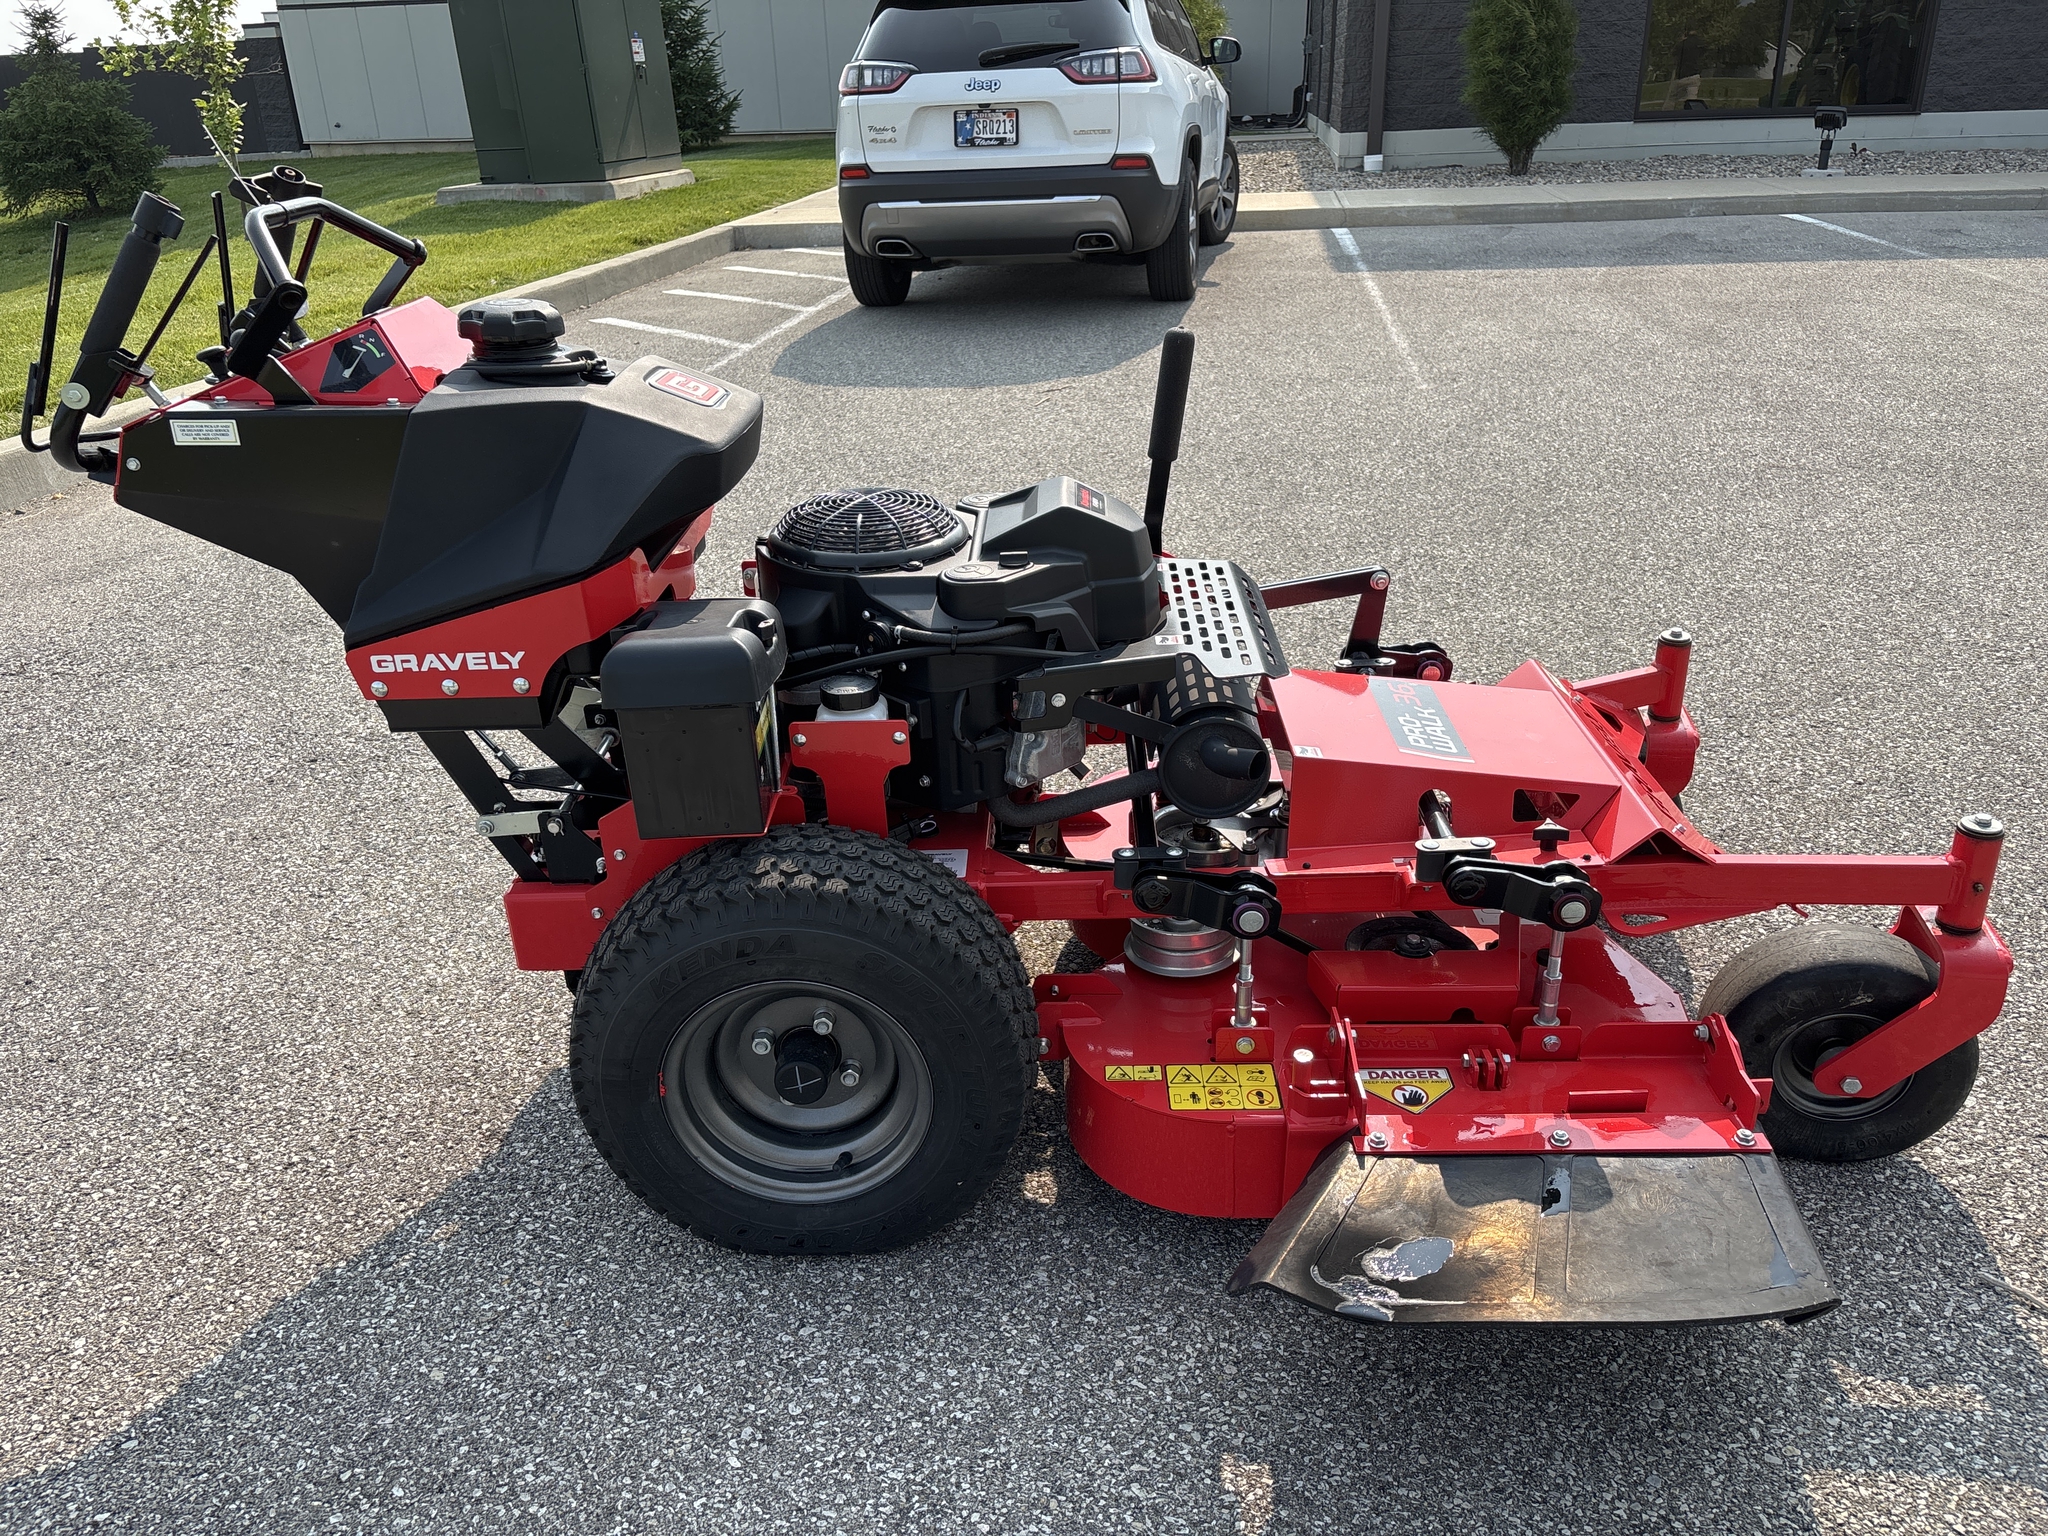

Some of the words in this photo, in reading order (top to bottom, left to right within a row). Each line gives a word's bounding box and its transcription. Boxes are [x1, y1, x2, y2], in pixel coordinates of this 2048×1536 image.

[964, 77, 1001, 93] Jeep
[369, 651, 526, 673] GRAVELY
[1386, 682, 1423, 707] 36
[1413, 705, 1459, 754] WALK
[649, 932, 797, 1002] KENDA
[854, 950, 976, 1056] SUPER
[1367, 1070, 1442, 1080] DANGER
